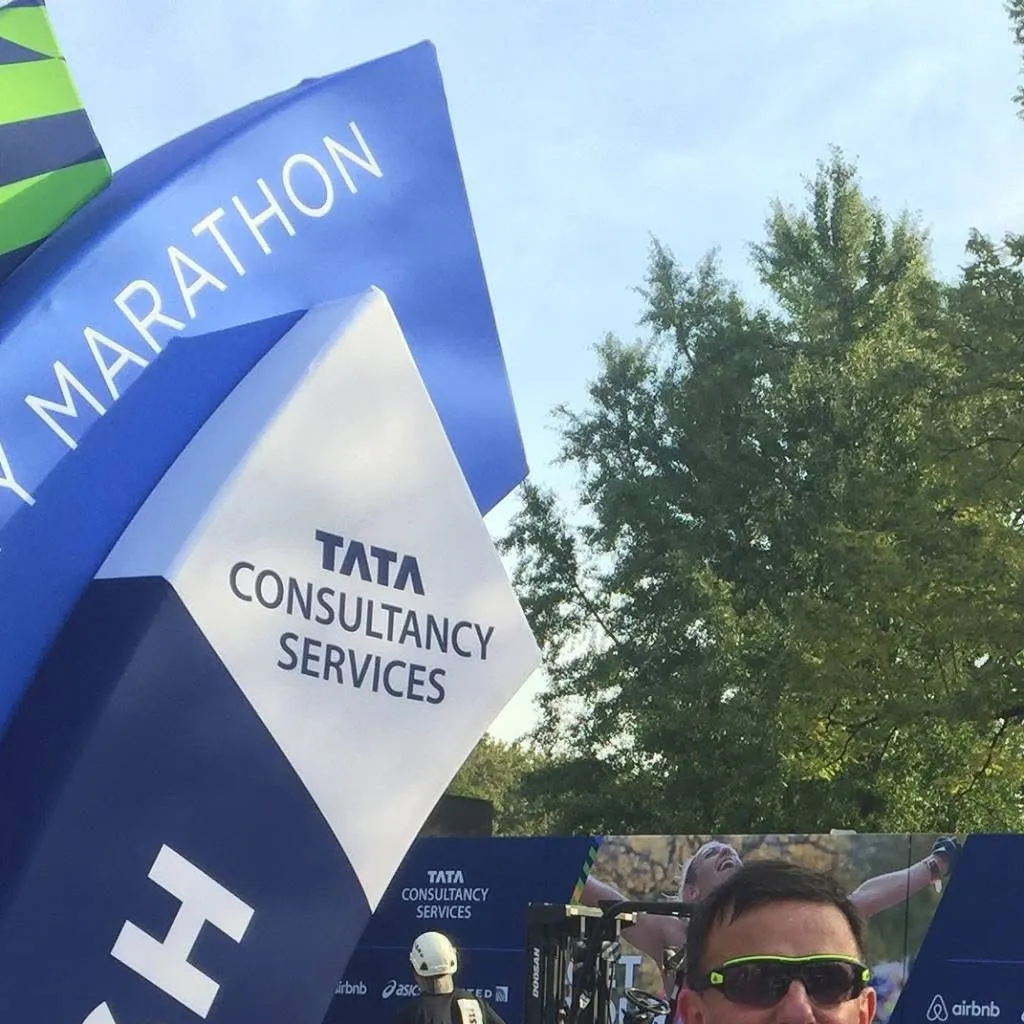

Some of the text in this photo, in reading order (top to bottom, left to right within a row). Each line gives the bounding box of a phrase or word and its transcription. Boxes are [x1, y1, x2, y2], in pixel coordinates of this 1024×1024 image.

[24, 121, 383, 450] MARATHON
[315, 529, 425, 597] TATA
[229, 561, 494, 661] CONSULTANCY
[277, 632, 446, 704] SERVICES
[401, 887, 489, 901] CONSULTANCY
[427, 870, 464, 884] TATA
[416, 905, 472, 919] SERVICES
[532, 947, 540, 998] DOOSAN
[952, 1001, 1000, 1017] airbnb
